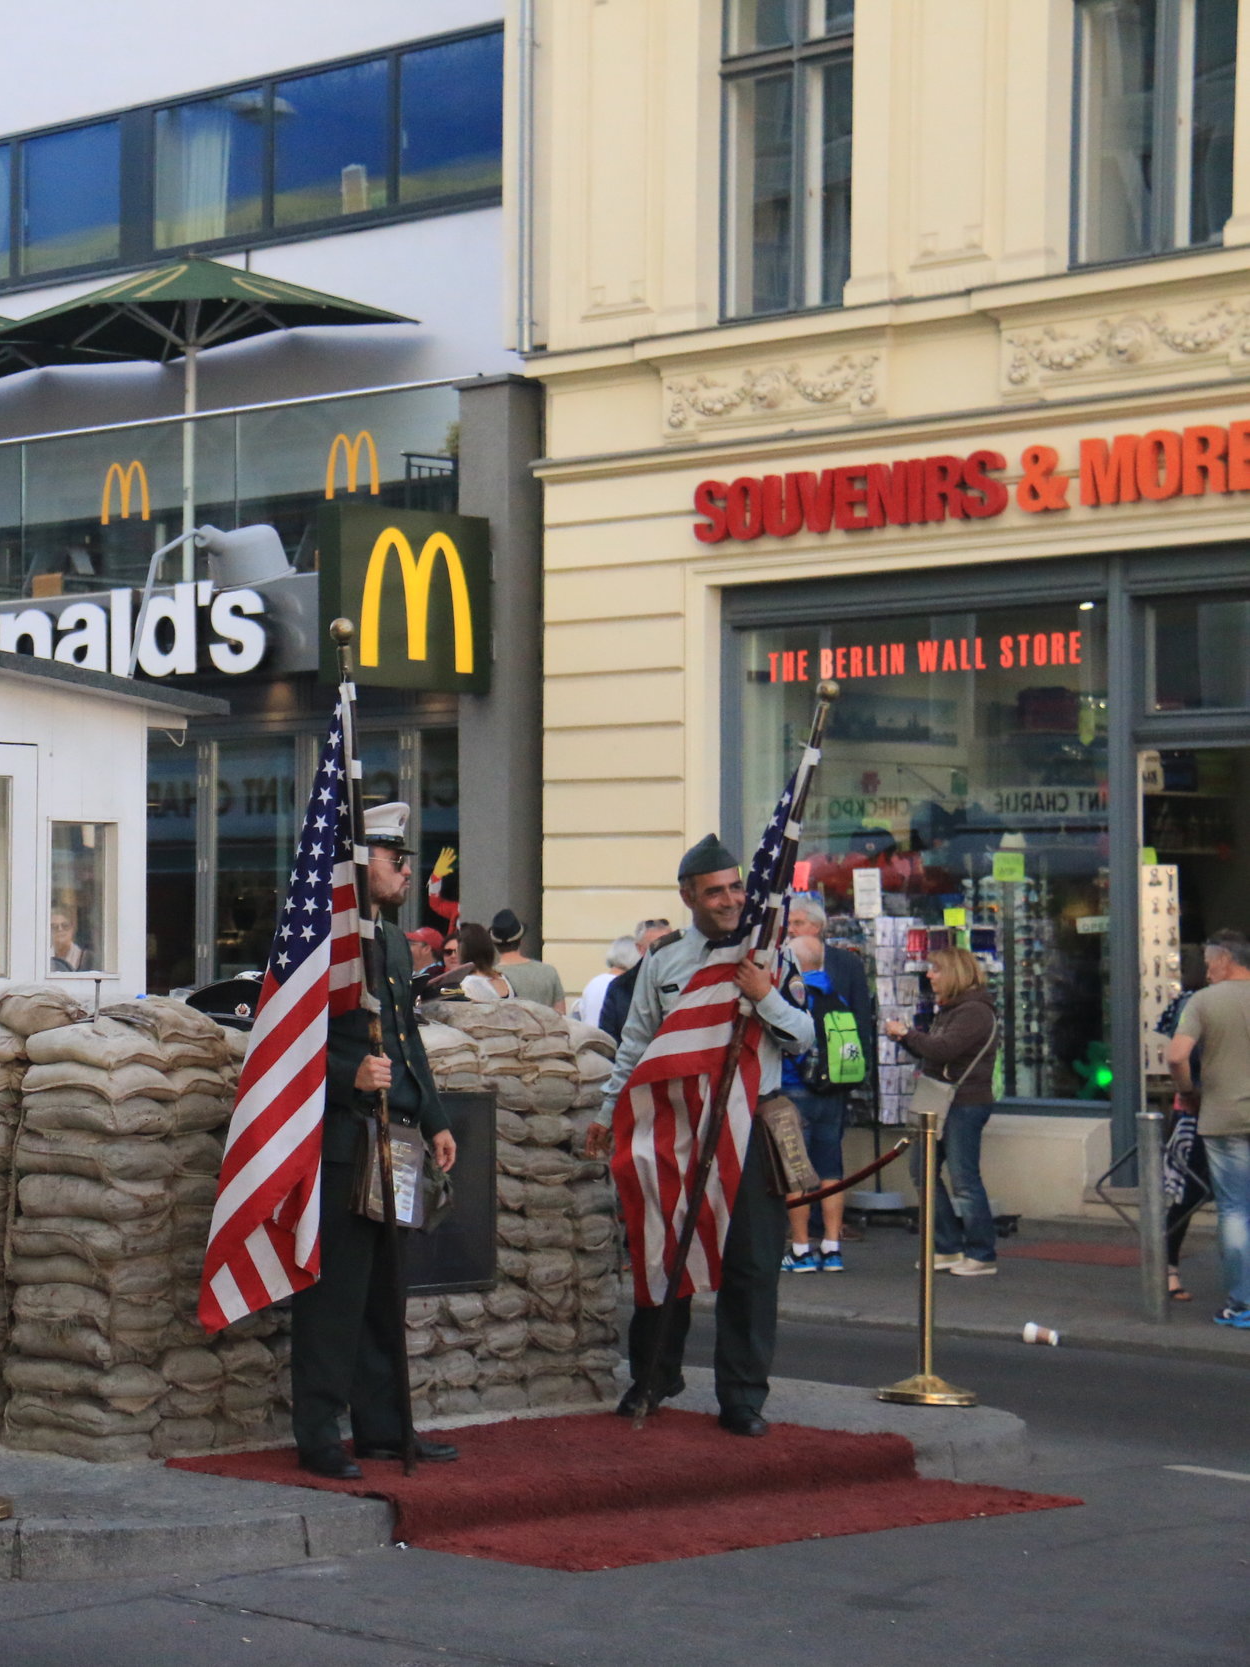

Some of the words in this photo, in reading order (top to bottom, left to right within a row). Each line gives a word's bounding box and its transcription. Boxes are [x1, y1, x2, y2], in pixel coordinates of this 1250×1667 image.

[693, 451, 1008, 544] SOUVENIRS
[1016, 445, 1069, 513] &
[1080, 421, 1250, 507] MORE
[769, 650, 808, 683] THE
[819, 641, 906, 680] BERLIN
[917, 637, 986, 672] WALL
[999, 631, 1082, 668] STORE
